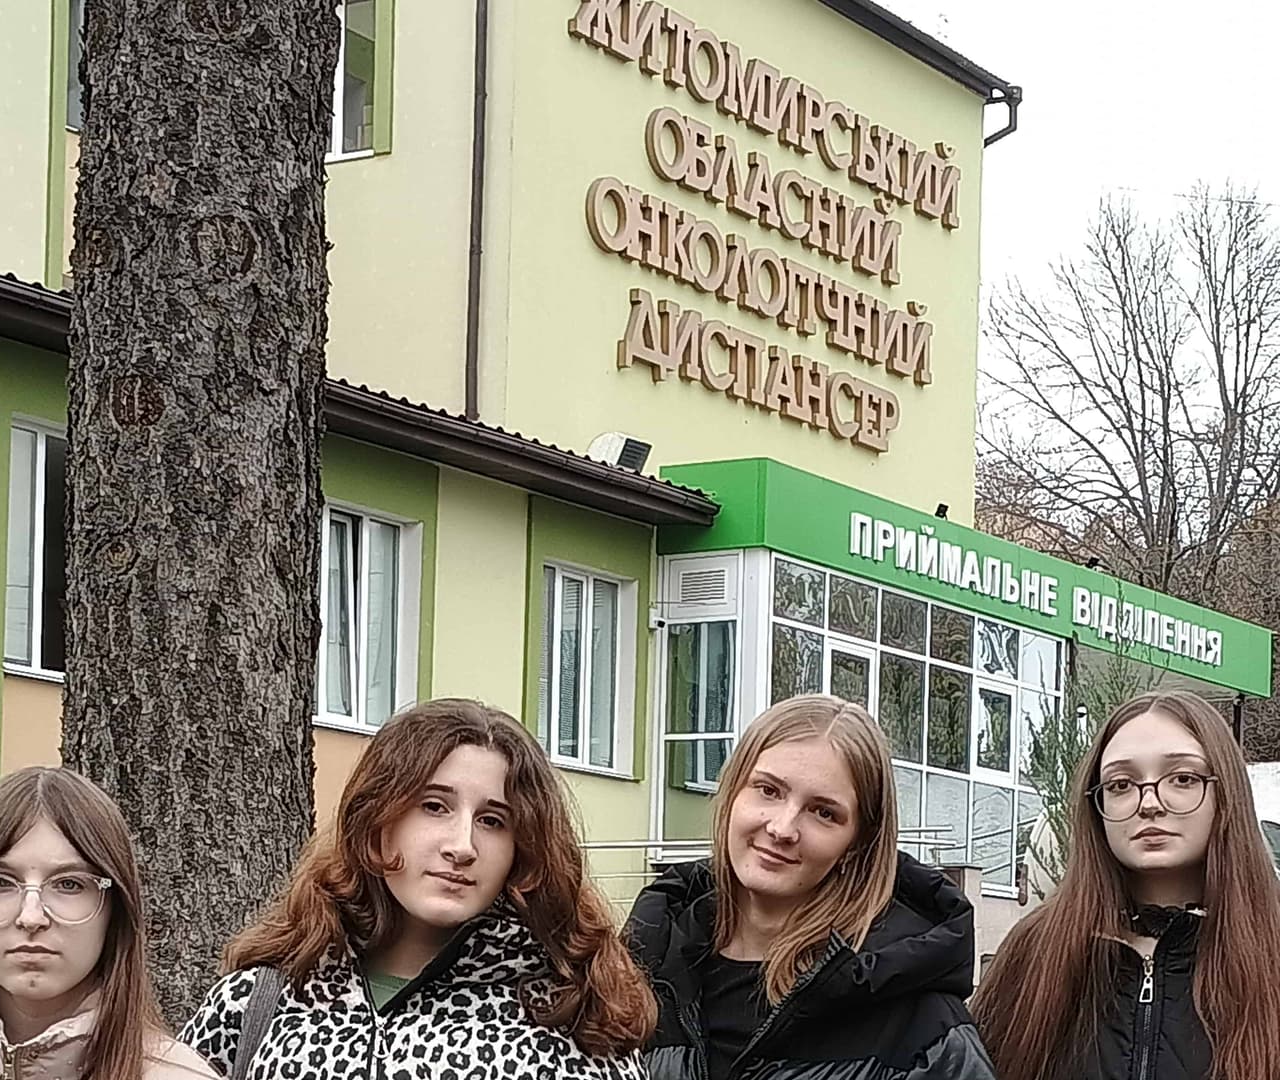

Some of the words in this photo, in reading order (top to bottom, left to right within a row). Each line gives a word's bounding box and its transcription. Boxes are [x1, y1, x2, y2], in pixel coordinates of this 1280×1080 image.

[568, 0, 961, 230] ЖИТОМИРСЬКИЙ
[646, 106, 902, 286] ОБЛАСНИЙ
[586, 176, 933, 386] ОНКОЛОГІЧНИЙ
[617, 288, 901, 453] ДИСПАНСЕР
[849, 512, 1059, 616] ПРИЙМАЛЬНЕ
[1072, 586, 1223, 667] ВІДДІЛЕННЯ
